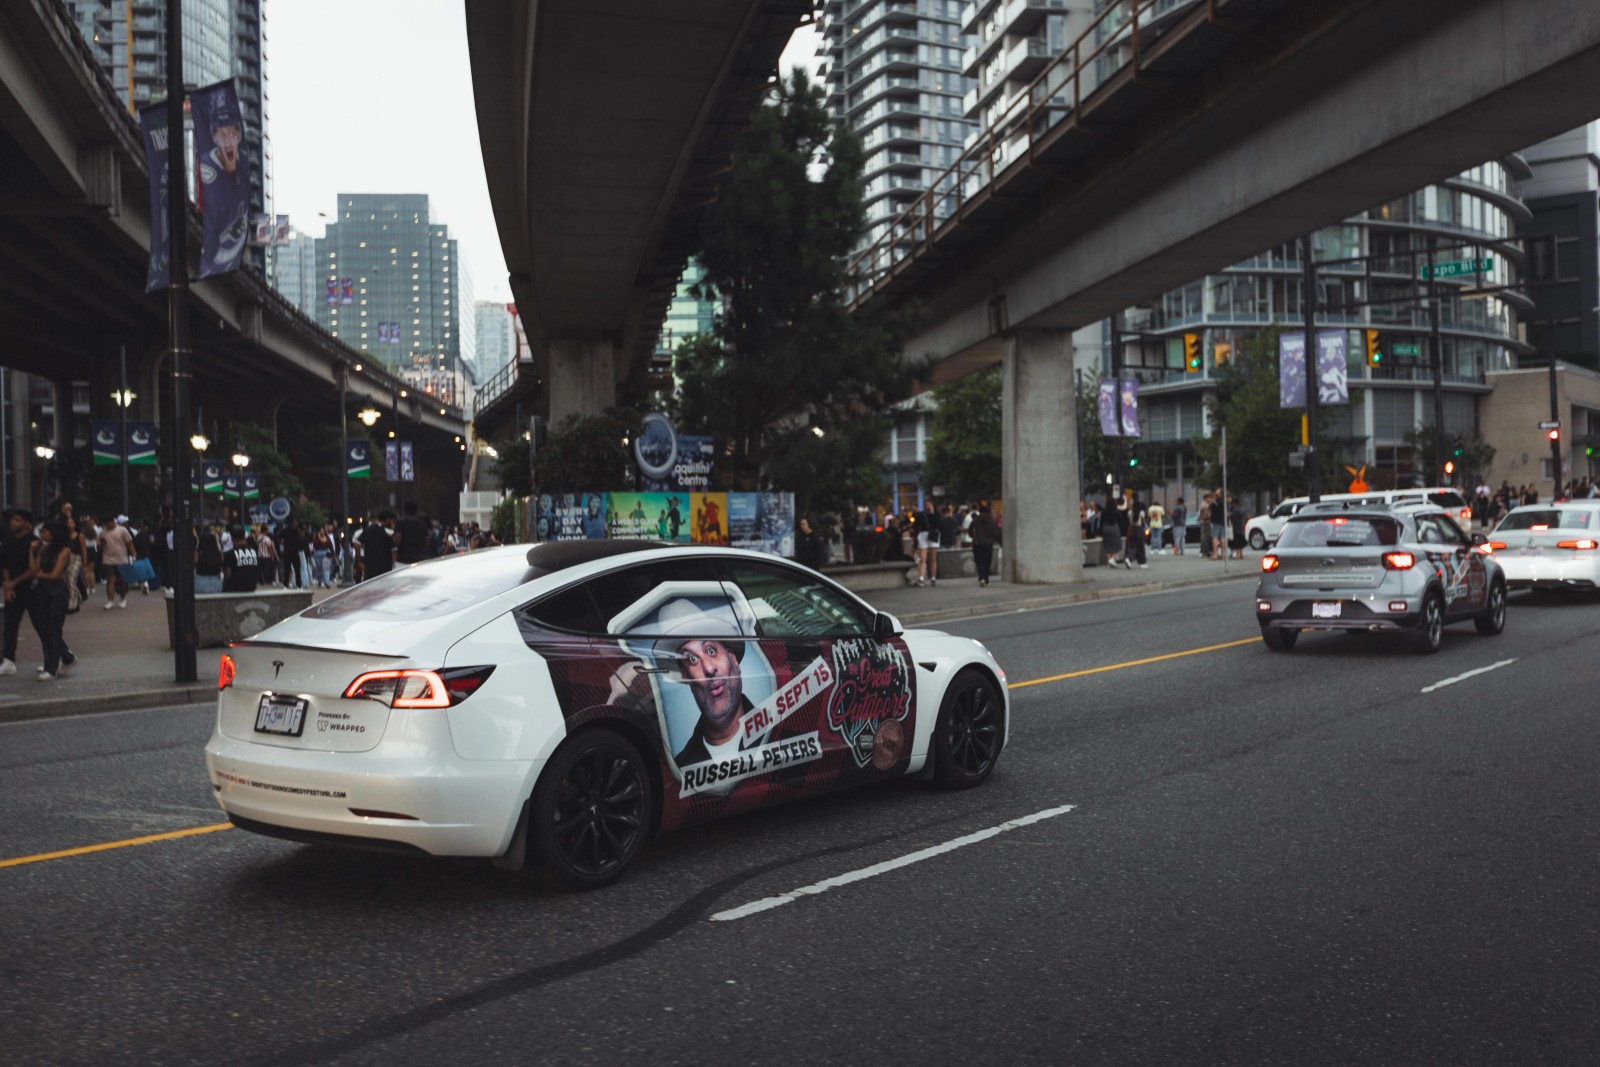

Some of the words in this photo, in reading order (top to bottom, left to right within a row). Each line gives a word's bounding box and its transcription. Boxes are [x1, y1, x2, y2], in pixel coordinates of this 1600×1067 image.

[1427, 263, 1456, 278] xpo
[678, 475, 708, 486] centre
[555, 507, 589, 516] EVERY
[562, 517, 583, 526] DAY
[562, 527, 573, 535] IS
[575, 527, 583, 535] A
[858, 658, 897, 692] Great
[743, 708, 774, 740] FRI,
[775, 684, 811, 715] SEPT
[812, 664, 830, 688] 15
[831, 680, 908, 726] Outdoors
[330, 723, 366, 733] WRAPPED
[683, 754, 758, 791] RUSSELL
[761, 737, 819, 770] PETERS
